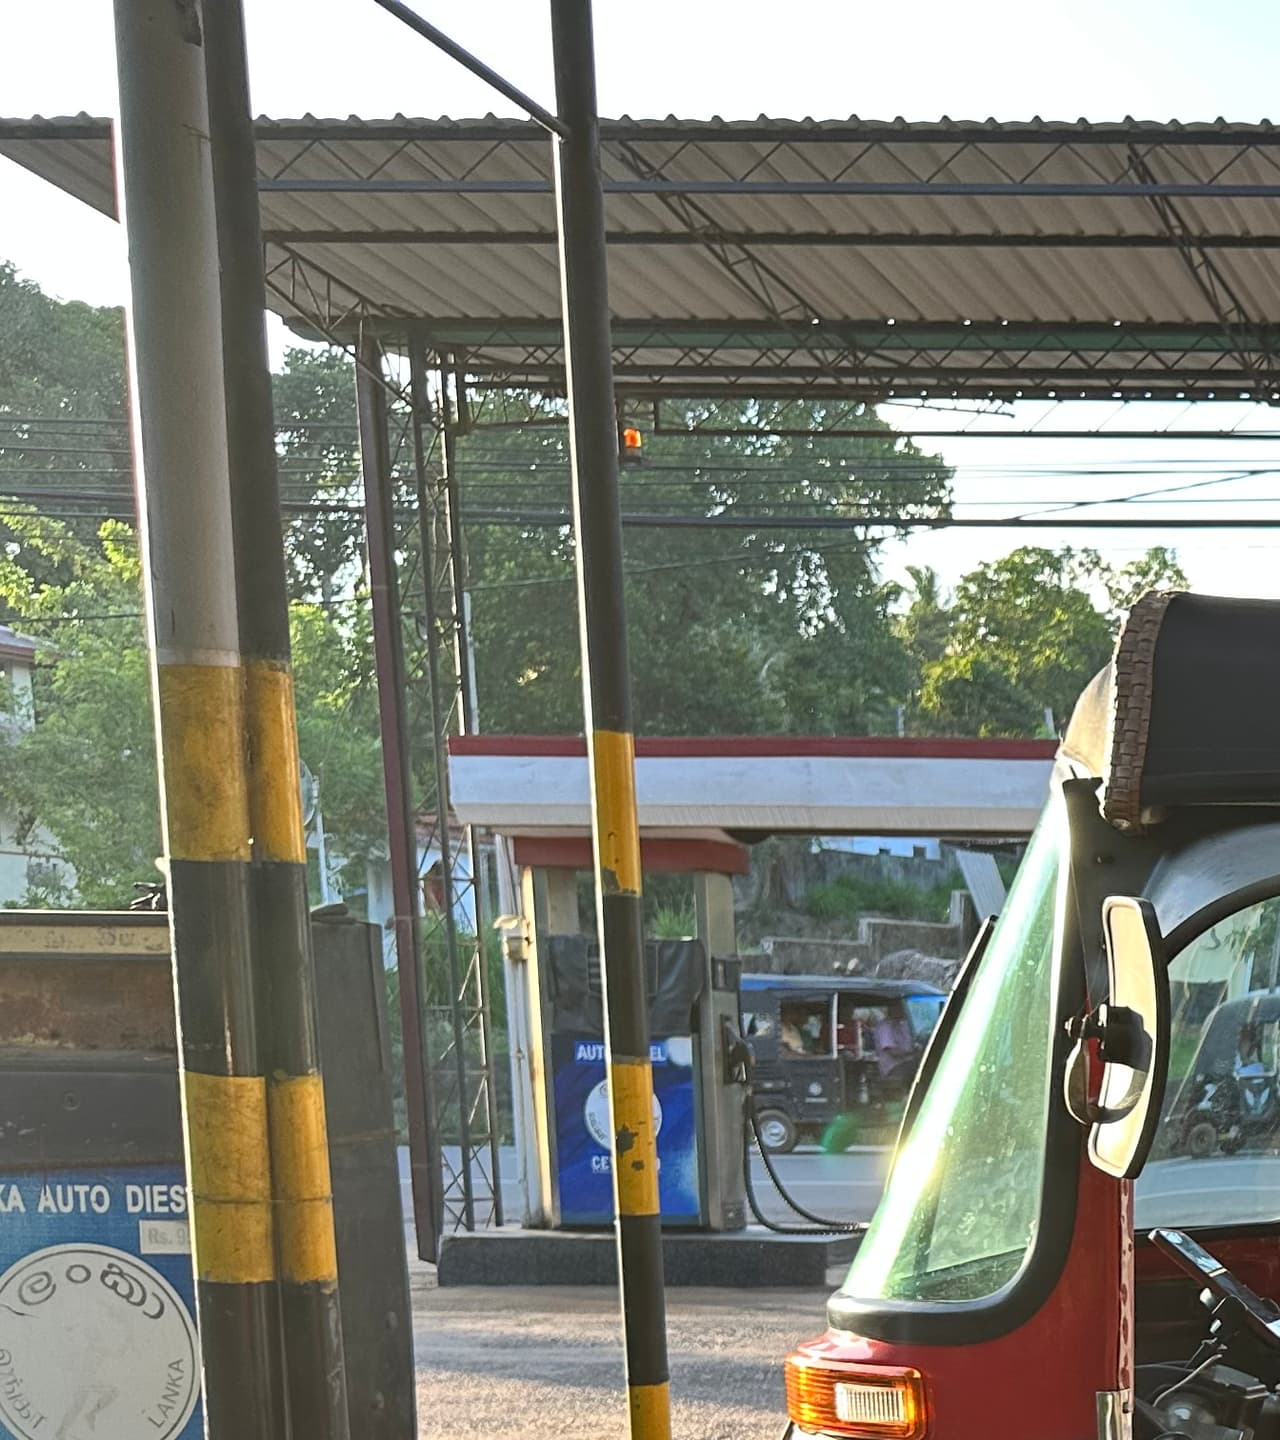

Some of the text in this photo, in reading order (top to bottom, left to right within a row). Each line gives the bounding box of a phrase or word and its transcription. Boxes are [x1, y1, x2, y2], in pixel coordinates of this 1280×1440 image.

[37, 1184, 111, 1214] AUTO
[125, 1184, 189, 1214] DIES
[147, 1357, 185, 1429] LANKA
